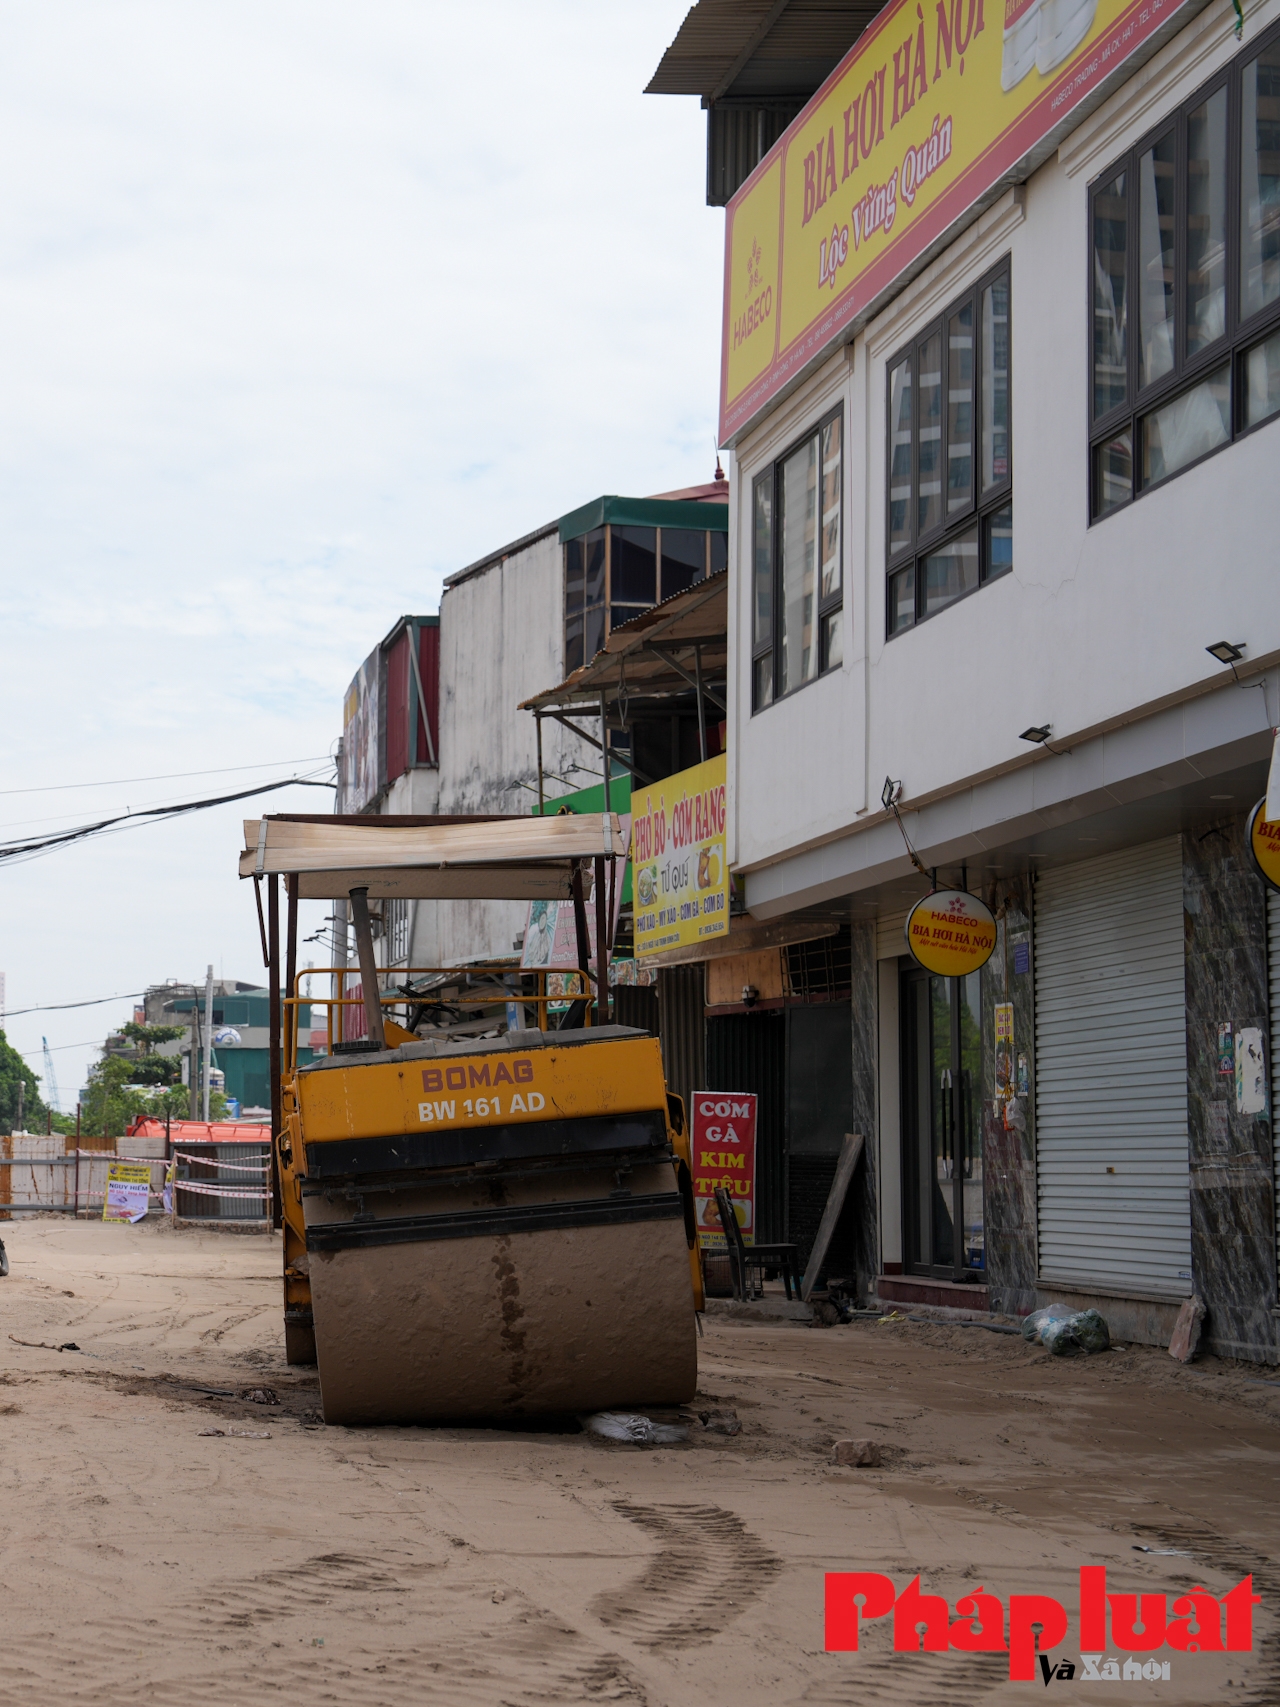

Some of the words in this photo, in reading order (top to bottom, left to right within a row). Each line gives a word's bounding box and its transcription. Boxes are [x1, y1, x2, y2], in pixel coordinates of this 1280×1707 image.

[801, 127, 837, 227] BIA
[841, 63, 886, 184] HƠI
[890, 17, 928, 130] HÀ
[818, 223, 849, 289] Lộc
[851, 167, 899, 252] Vừng
[900, 112, 953, 208] Quán
[733, 285, 772, 351] HABECO
[634, 795, 652, 864] PHỞ
[654, 796, 665, 857] BÒ
[673, 790, 693, 849] CƠM
[695, 784, 726, 844] RANG
[930, 911, 979, 927] HABECO
[912, 924, 930, 937] BIA
[932, 928, 953, 941] HƠI
[955, 931, 971, 945] HÀ
[972, 935, 993, 950] NỘI
[422, 1059, 534, 1093] BOMAG
[418, 1099, 456, 1123] BW
[462, 1096, 502, 1119] 161
[509, 1092, 546, 1114] AD
[699, 1099, 750, 1119] CƠM
[705, 1123, 740, 1144] GÀ
[700, 1151, 746, 1169] KIM
[695, 1175, 751, 1195] TIÊU
